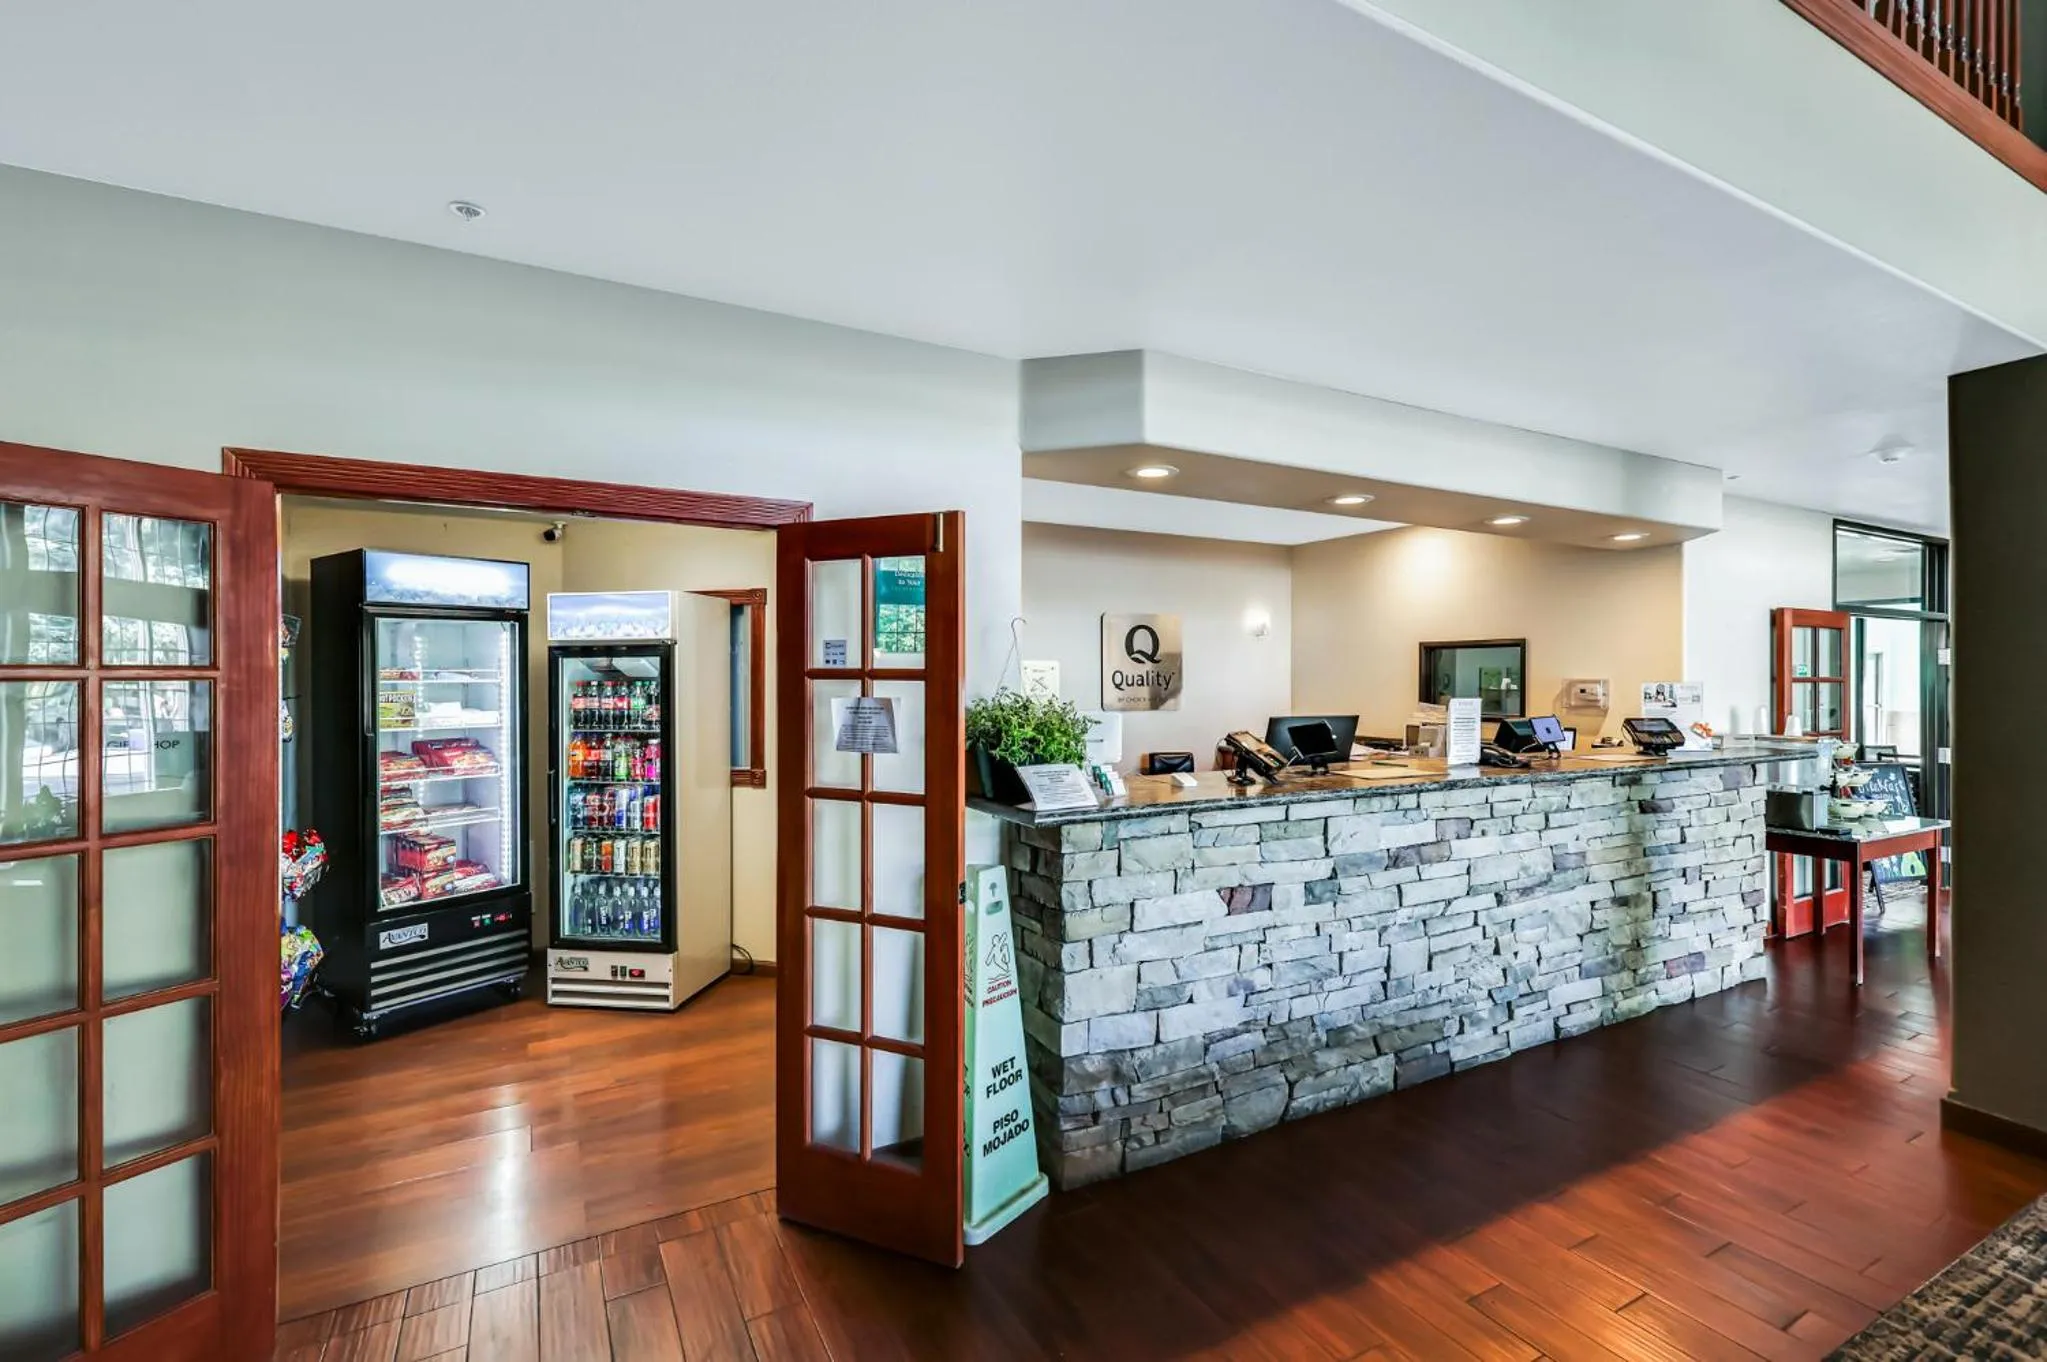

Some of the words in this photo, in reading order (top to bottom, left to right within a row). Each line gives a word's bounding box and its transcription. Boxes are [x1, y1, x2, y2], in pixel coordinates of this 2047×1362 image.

[1125, 624, 1162, 664] Q
[1111, 669, 1172, 691] Quality
[153, 739, 181, 750] HOP
[991, 1056, 1016, 1079] WET
[986, 1069, 1023, 1099] FLOOR
[993, 1109, 1019, 1134] PISO
[983, 1119, 1030, 1157] MOJADO
